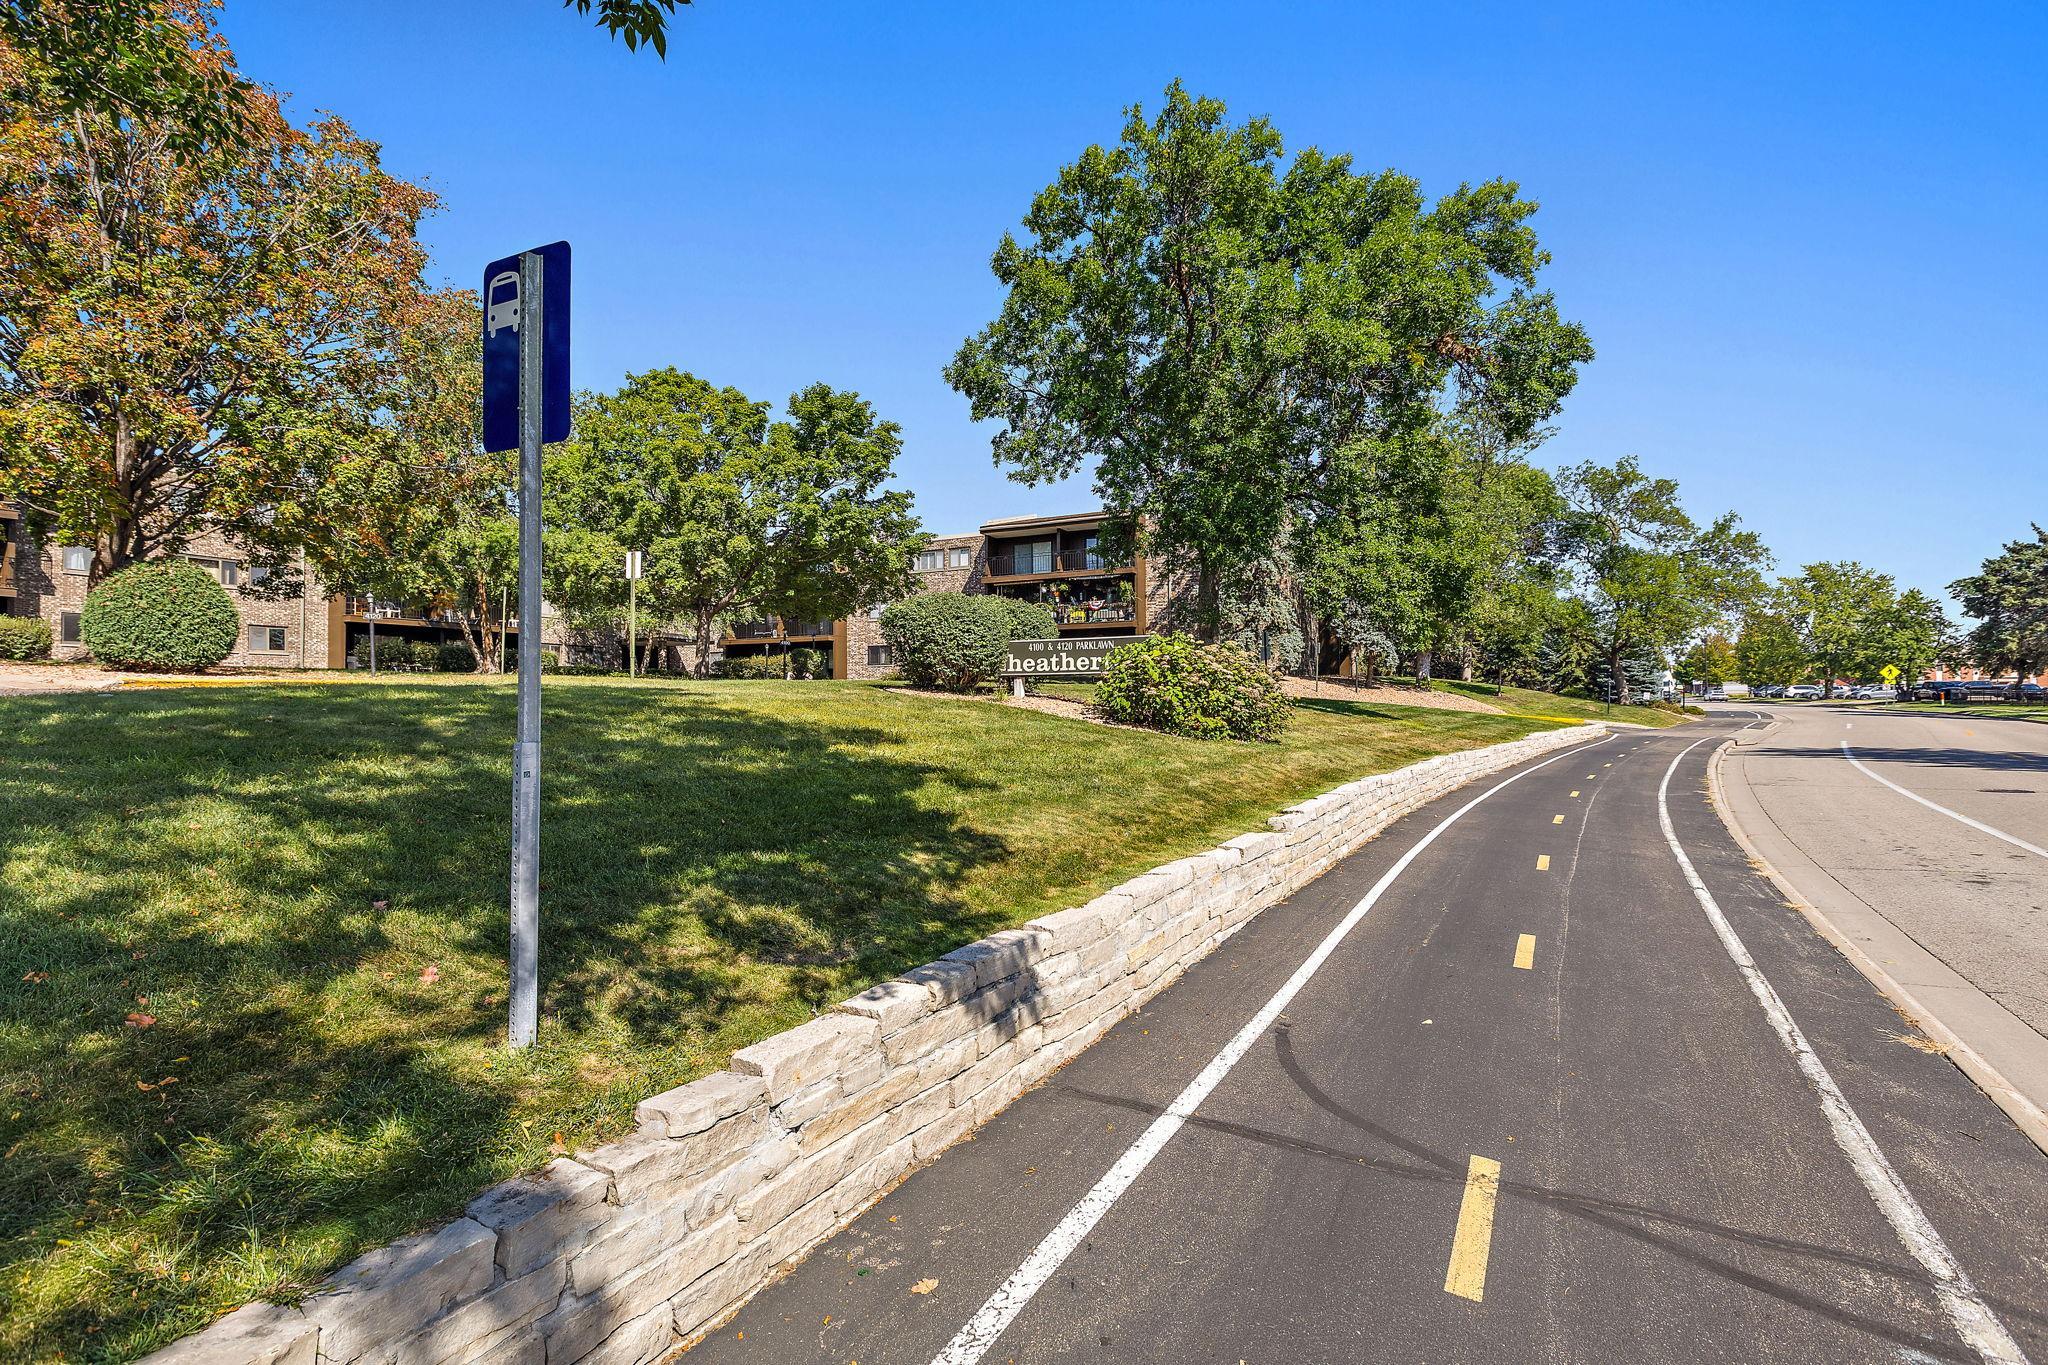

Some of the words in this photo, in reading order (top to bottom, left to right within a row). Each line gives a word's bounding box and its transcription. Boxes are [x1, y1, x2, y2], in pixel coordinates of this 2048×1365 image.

[1028, 642, 1045, 652] 4100
[1047, 642, 1054, 651] &
[1056, 641, 1073, 651] 4120
[1076, 640, 1115, 650] PARKLAWN
